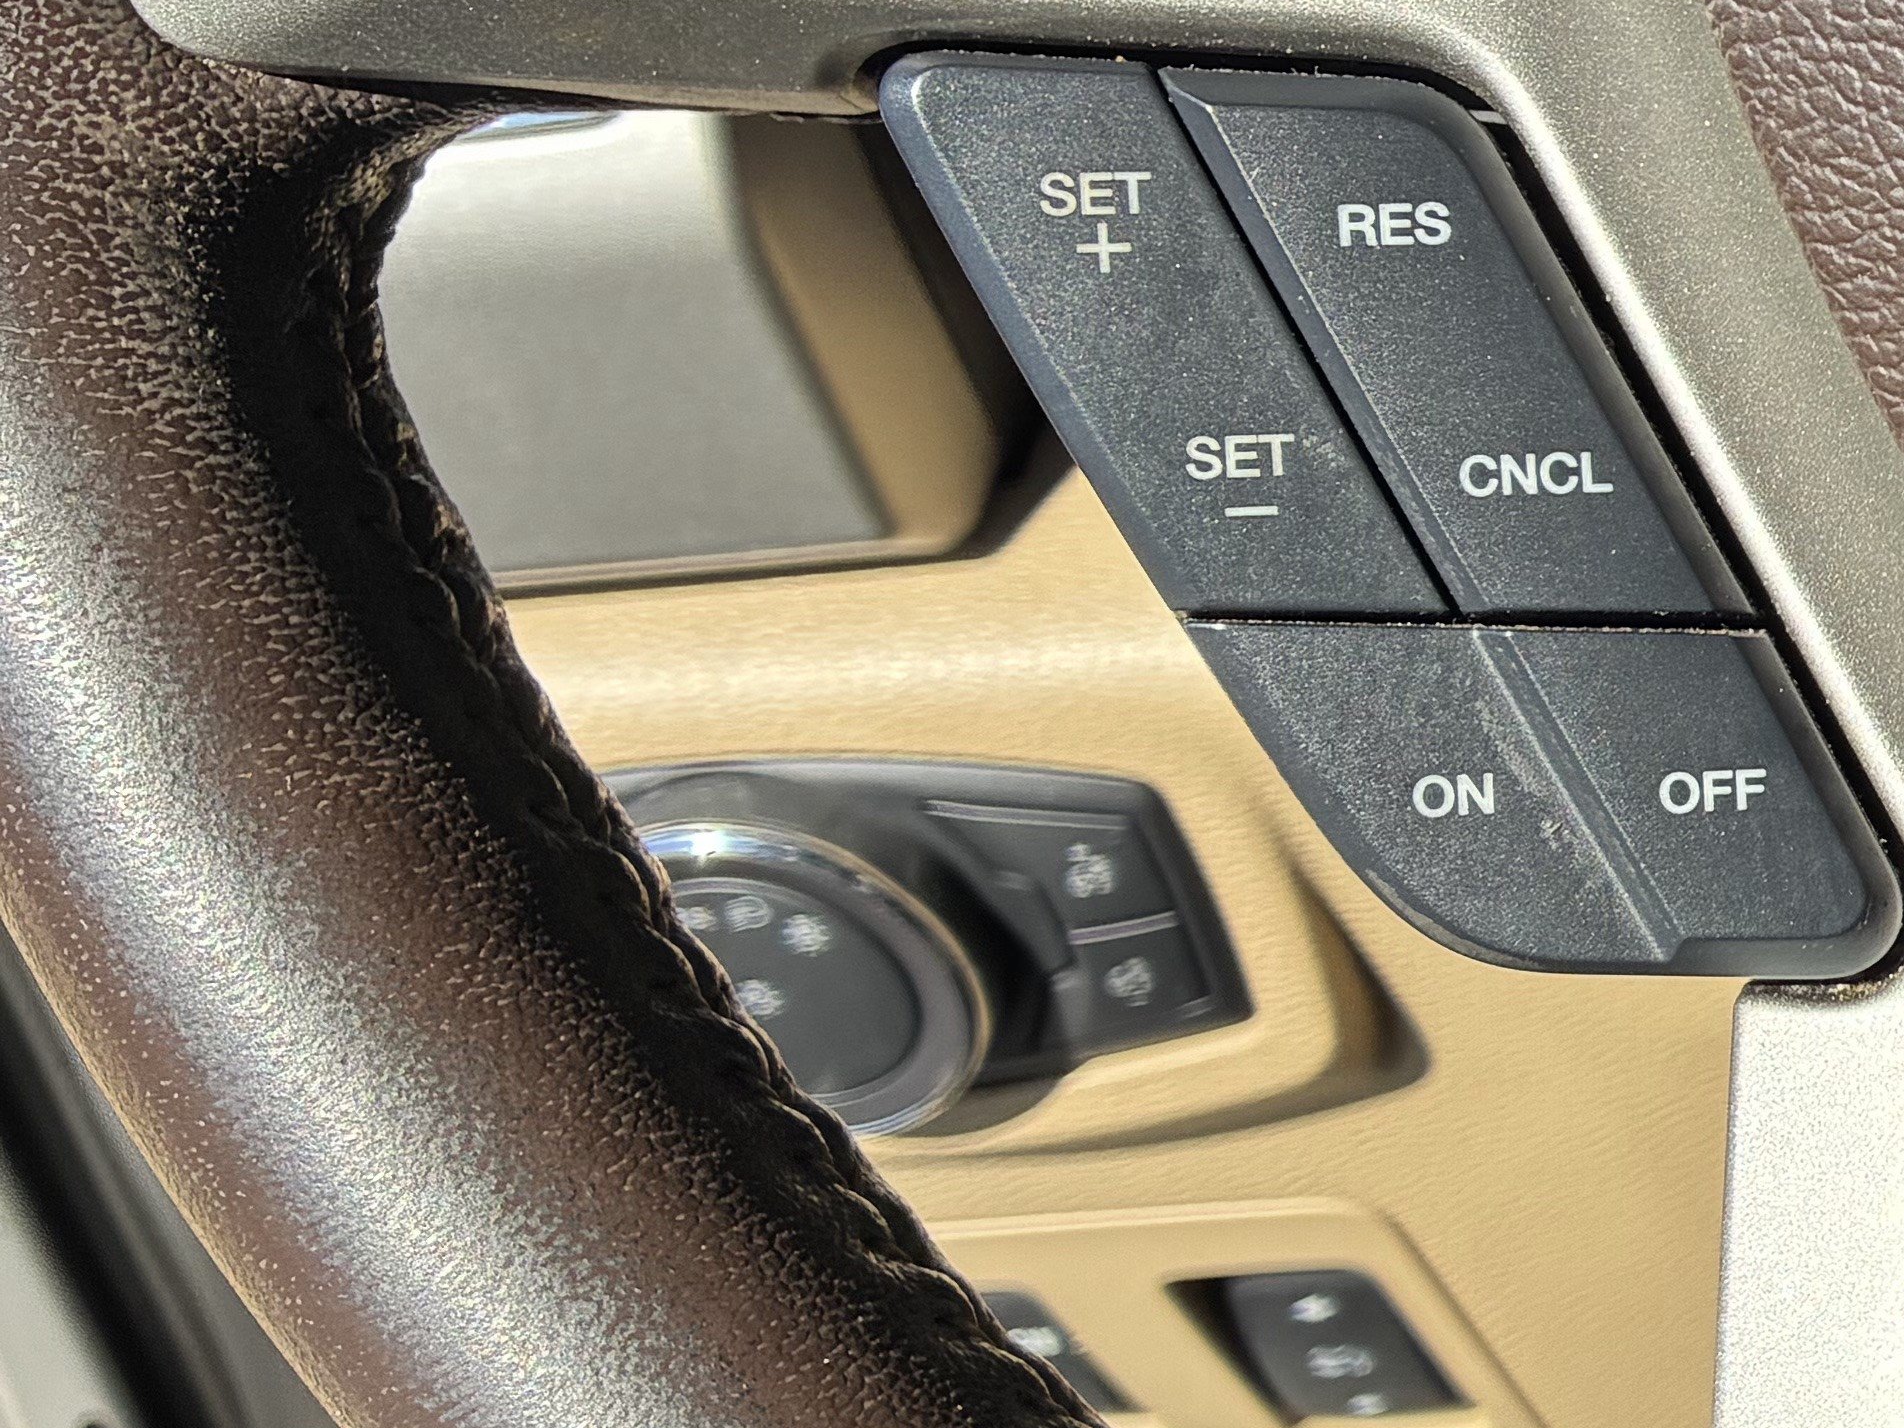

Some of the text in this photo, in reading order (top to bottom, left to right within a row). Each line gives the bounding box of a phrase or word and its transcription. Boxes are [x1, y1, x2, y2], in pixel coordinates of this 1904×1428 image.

[1039, 171, 1152, 216] SET
[1337, 202, 1451, 249] RES
[1185, 433, 1295, 480] SET
[1458, 452, 1614, 497] CNCL
[1412, 773, 1495, 818] ON
[1659, 768, 1767, 815] OFF
